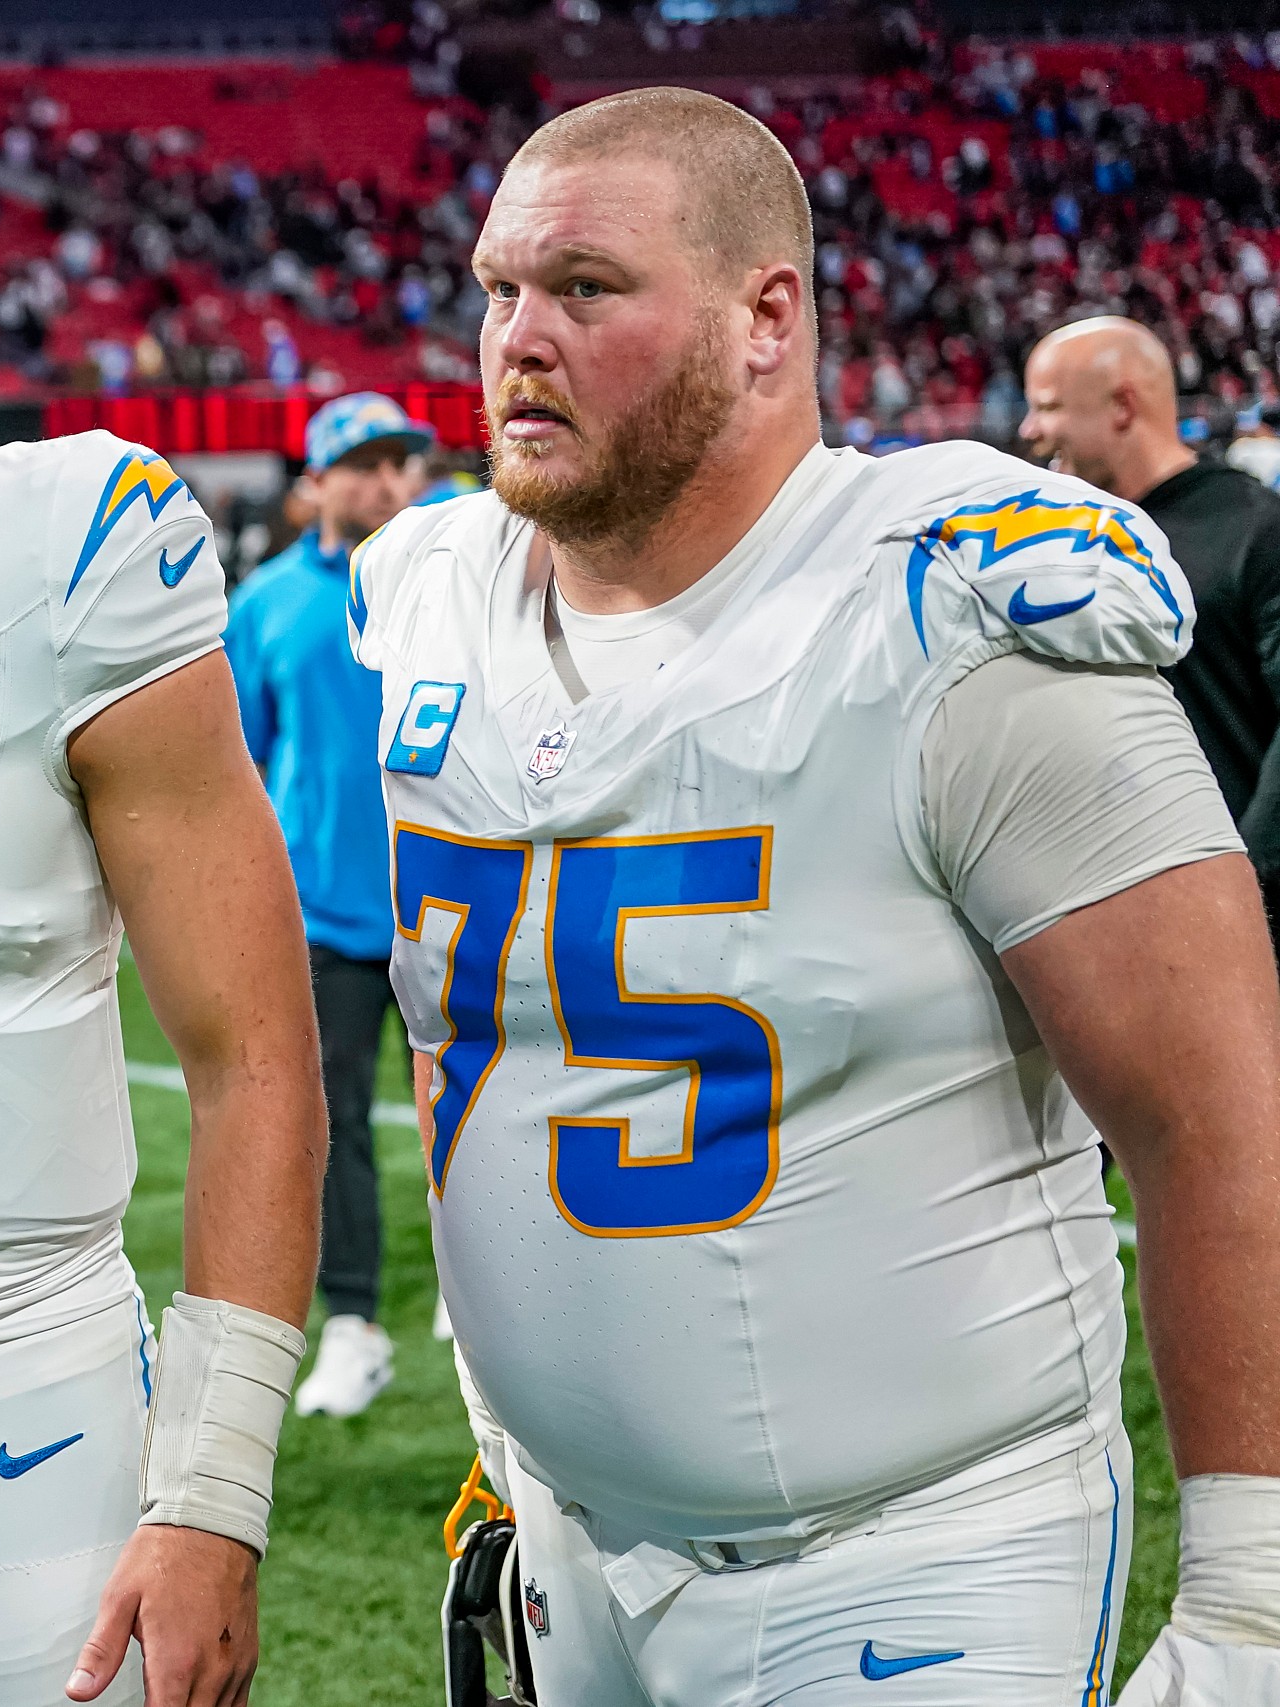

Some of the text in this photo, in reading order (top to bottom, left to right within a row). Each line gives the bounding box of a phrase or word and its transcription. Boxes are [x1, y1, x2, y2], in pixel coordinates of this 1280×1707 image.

[400, 687, 457, 748] C
[531, 749, 560, 772] NFL
[393, 820, 783, 1239] 75
